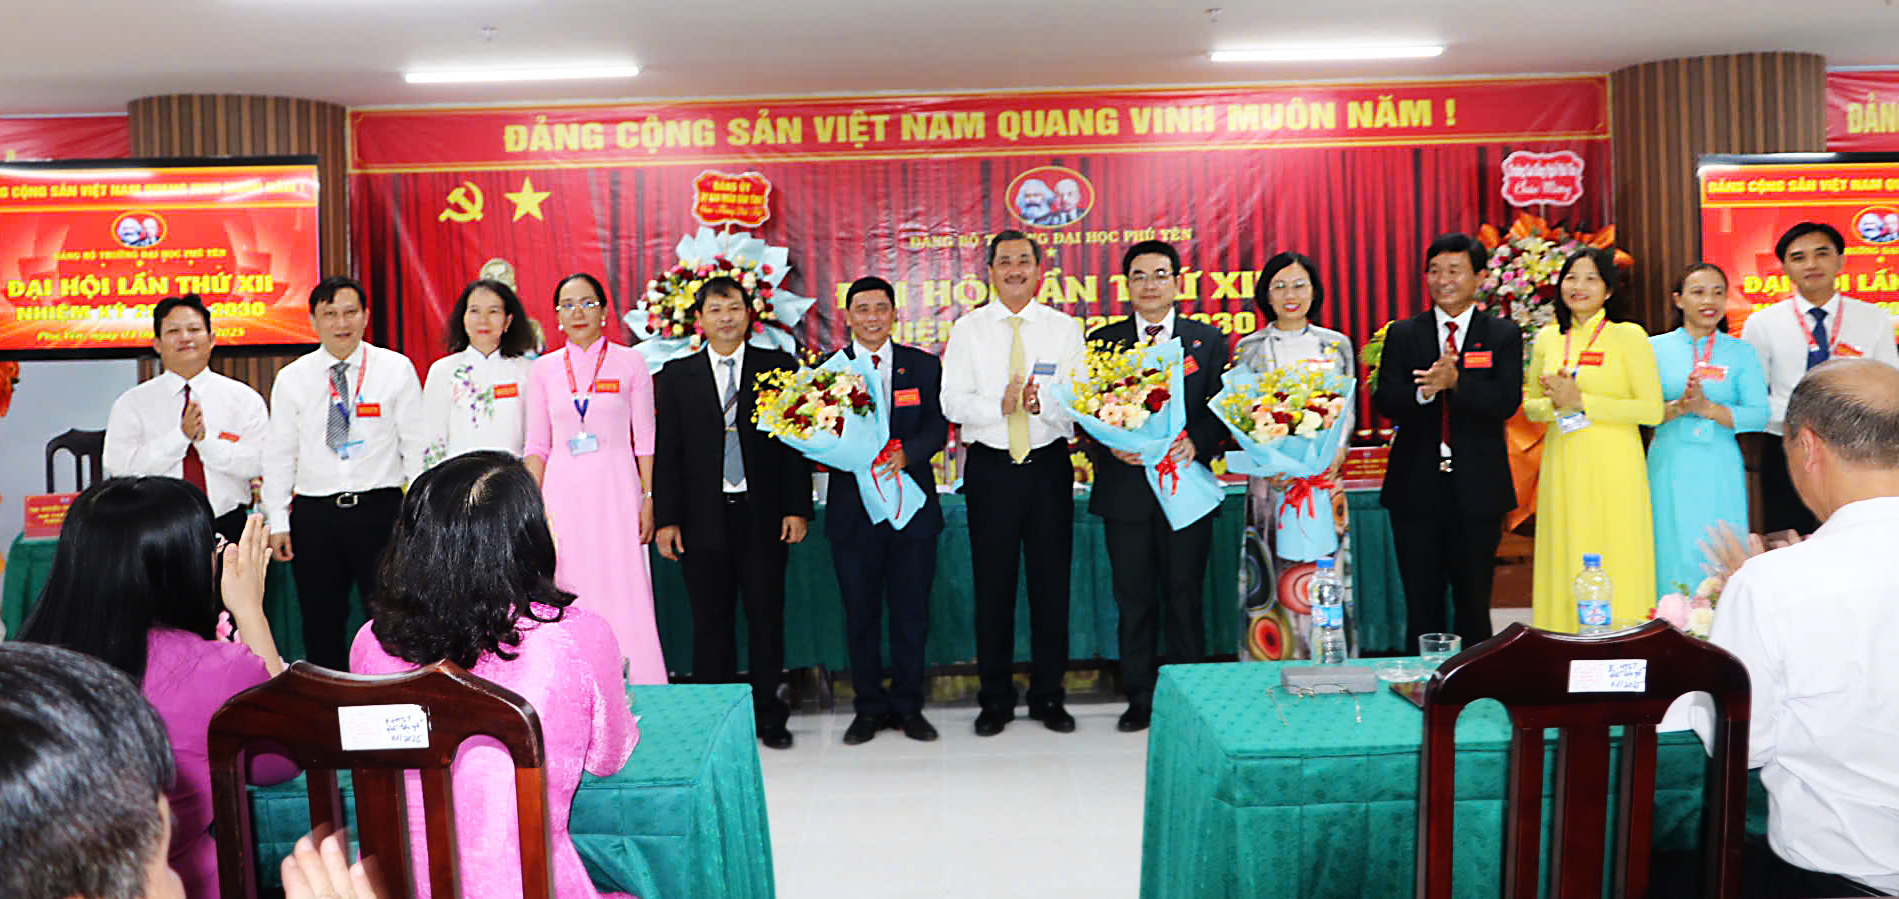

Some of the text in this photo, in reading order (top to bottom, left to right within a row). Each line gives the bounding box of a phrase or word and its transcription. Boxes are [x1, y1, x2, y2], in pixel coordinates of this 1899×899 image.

[503, 94, 1457, 154] ĐẢNG CỘNG SẢN VIỆT NAM QUANG VINH MUÔN NĂM !
[50, 182, 78, 198] SẢN
[80, 183, 107, 199] VIỆT
[1748, 178, 1786, 194] CỘNG
[1788, 176, 1817, 192] SẢN
[1819, 177, 1847, 193] VIỆT
[1850, 178, 1883, 191] NAM
[1053, 231, 1082, 246] ĐẠI
[1085, 231, 1119, 246] HỌC
[1122, 227, 1155, 242] PHÚ
[1159, 227, 1193, 242] YÊN
[7, 279, 52, 300] ĐẠI
[59, 274, 110, 299] HỘI
[175, 271, 232, 294] THỨ
[235, 273, 274, 293] XII
[922, 273, 998, 312] HỘ
[1211, 270, 1263, 299] XI
[16, 302, 91, 322] NHIỆM
